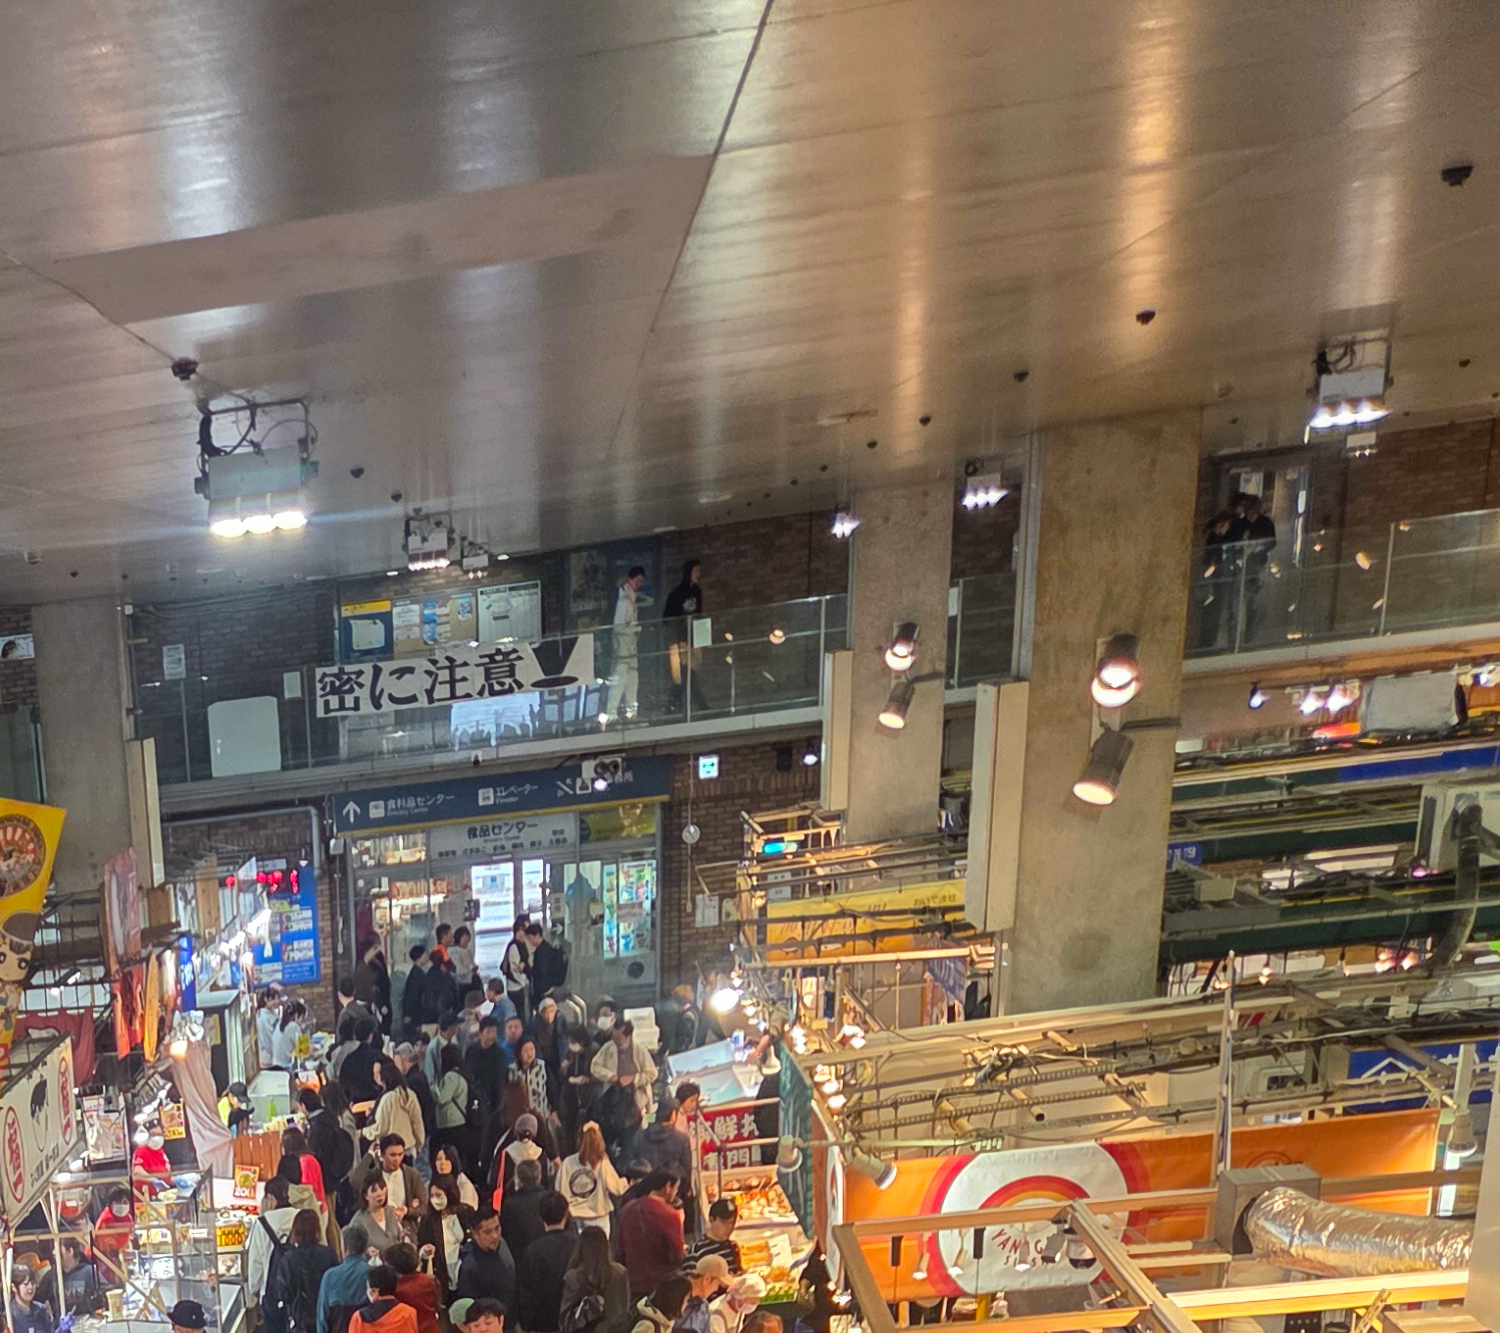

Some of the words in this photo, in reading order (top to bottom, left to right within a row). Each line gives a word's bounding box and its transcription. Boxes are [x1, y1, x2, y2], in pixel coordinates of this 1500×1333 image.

[496, 783, 539, 798] エレベーター
[387, 793, 455, 811] 食料品センター
